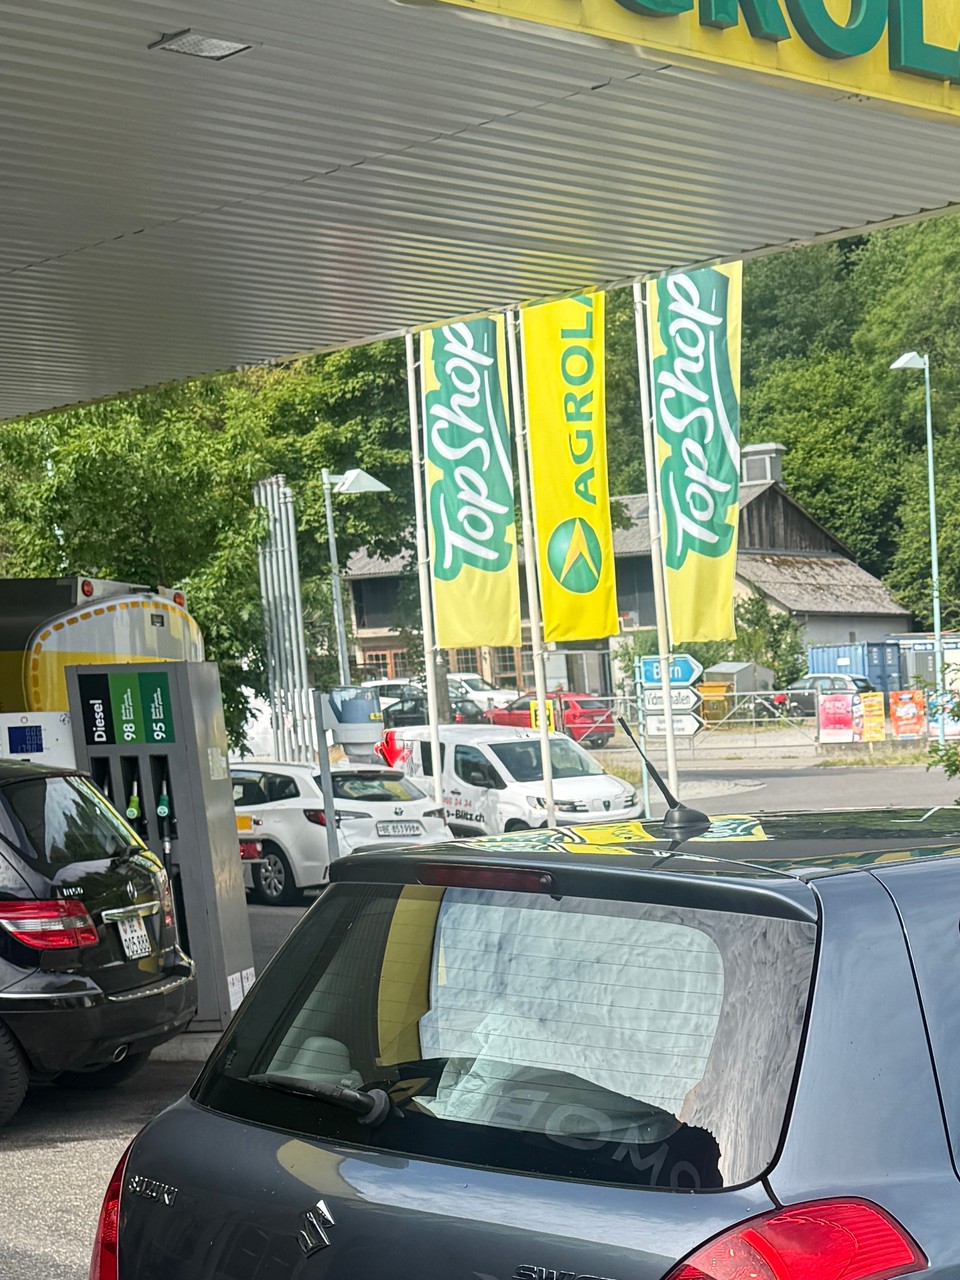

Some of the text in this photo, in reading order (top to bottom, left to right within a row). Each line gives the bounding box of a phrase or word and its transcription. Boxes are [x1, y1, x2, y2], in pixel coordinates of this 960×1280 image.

[653, 662, 682, 680] Brn
[89, 700, 107, 742] Diesel
[123, 723, 136, 741] 98
[152, 722, 166, 740] 95
[128, 1175, 178, 1206] SUZUKI
